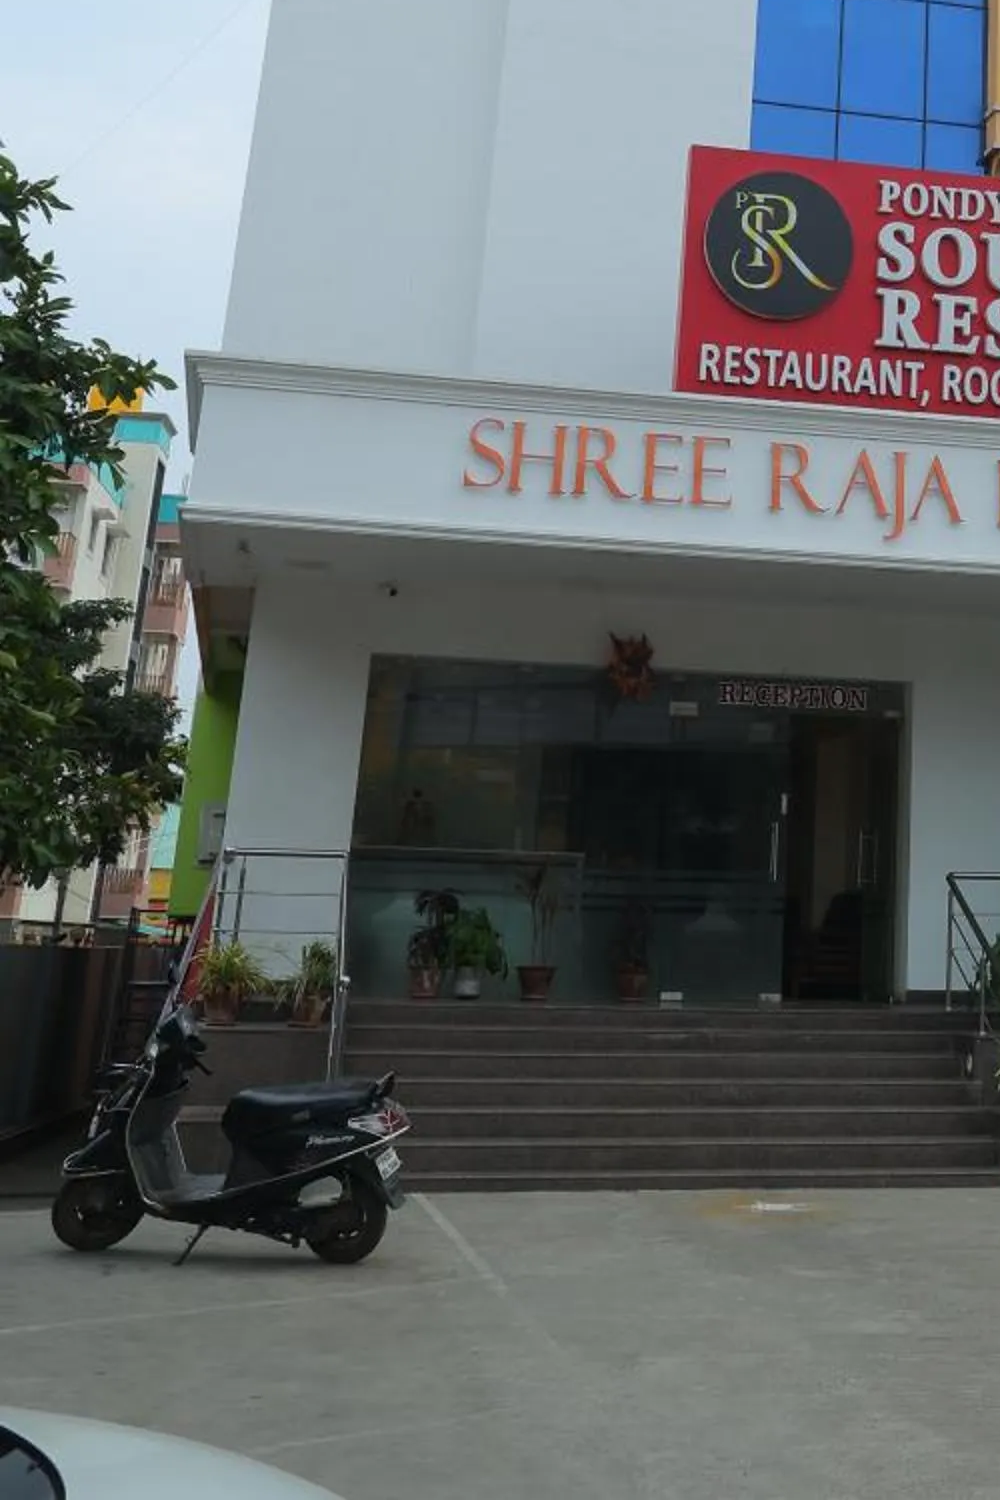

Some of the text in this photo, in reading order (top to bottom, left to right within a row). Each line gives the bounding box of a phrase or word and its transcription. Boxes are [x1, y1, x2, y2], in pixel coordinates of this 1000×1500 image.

[697, 342, 931, 408] RESTAURANT,
[462, 417, 733, 509] SHREE
[767, 441, 967, 541] RAJA
[719, 681, 869, 711] RECEPTION
